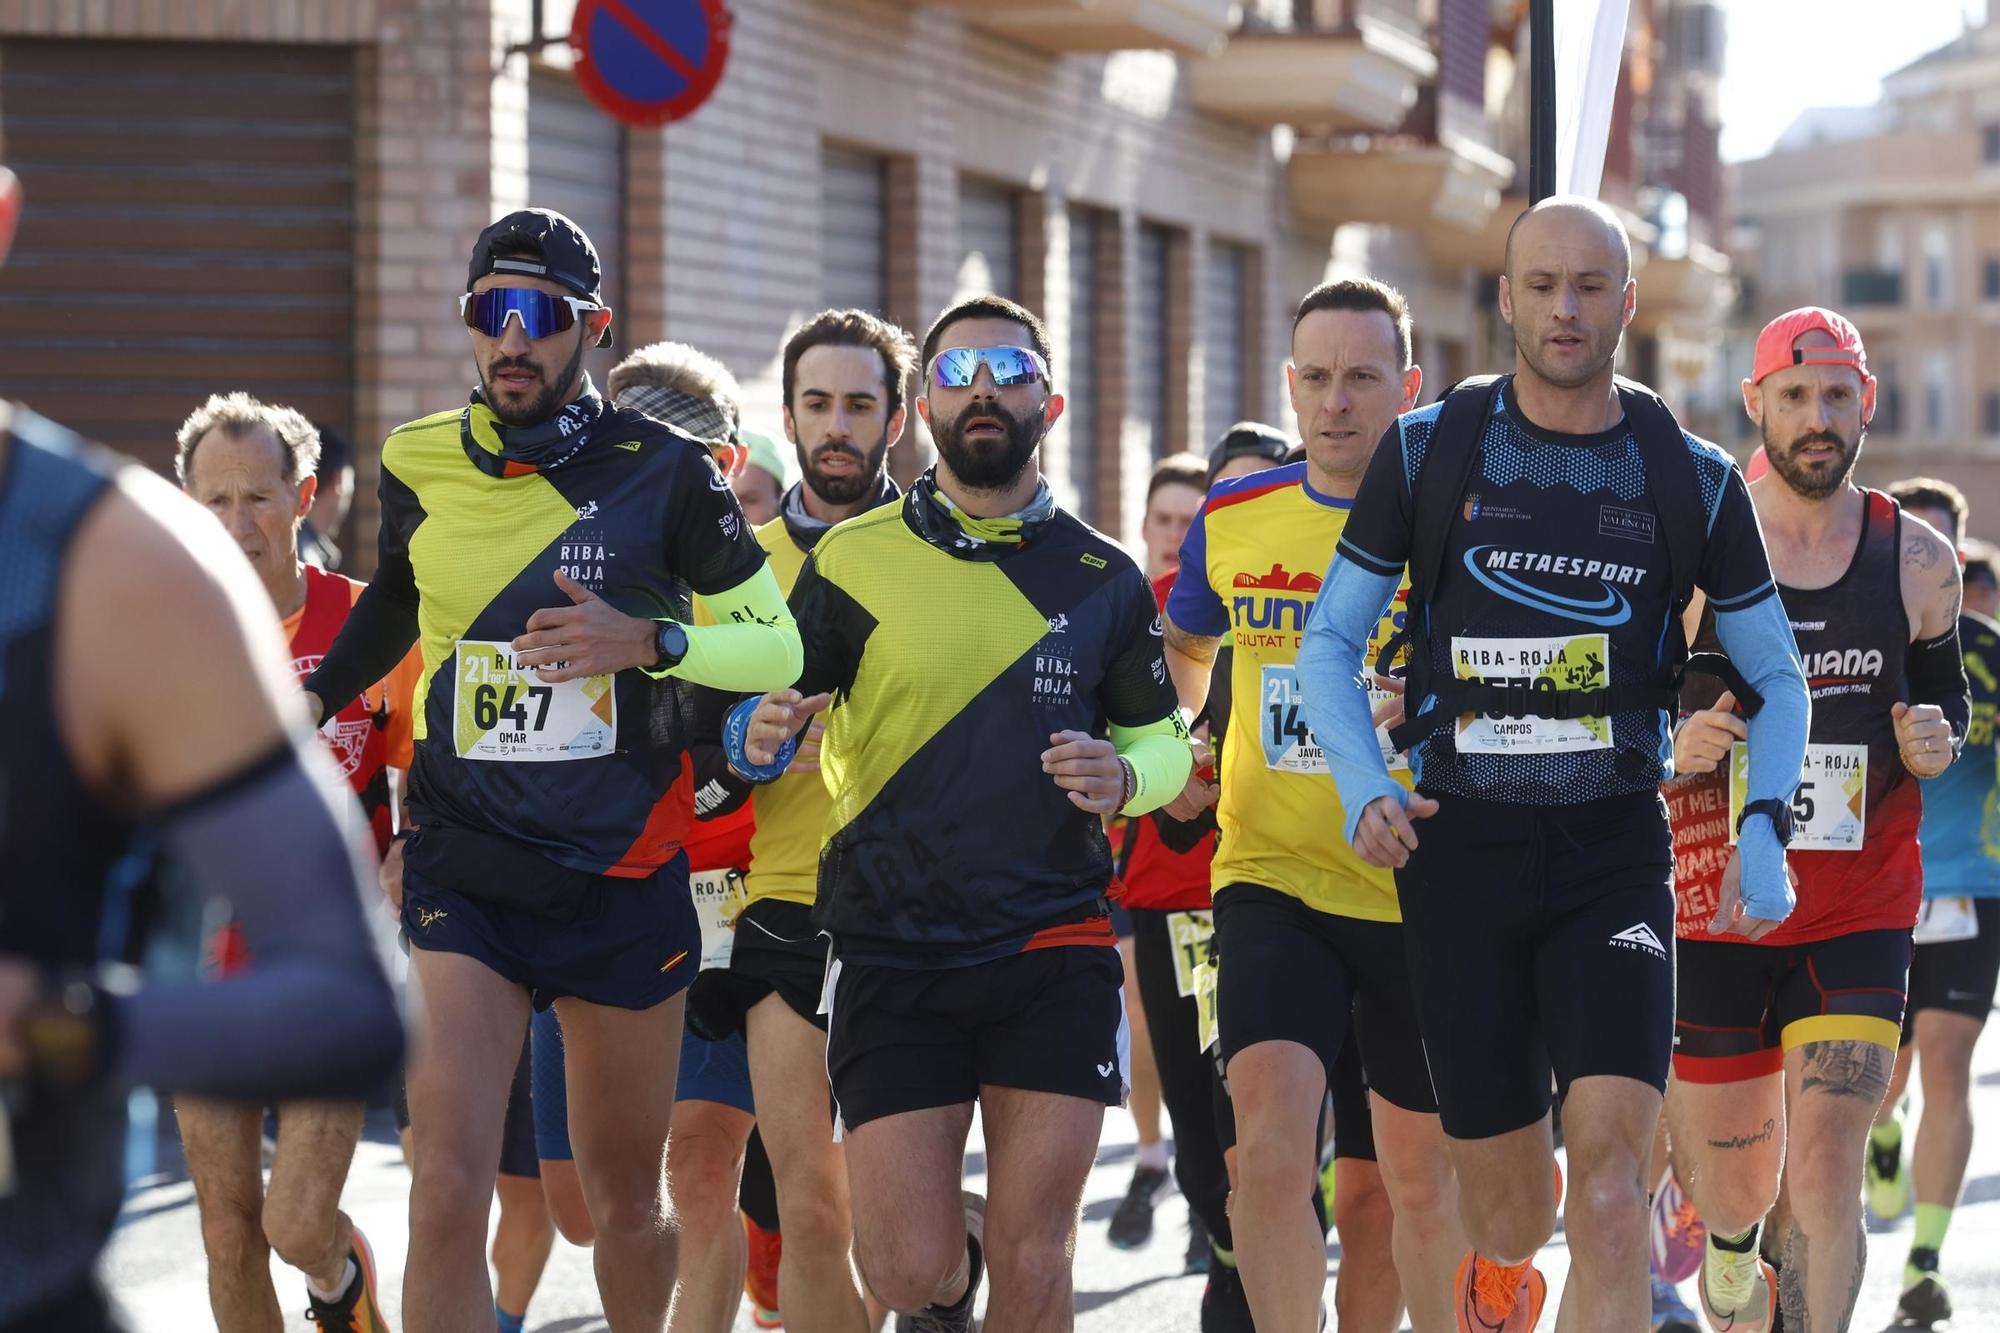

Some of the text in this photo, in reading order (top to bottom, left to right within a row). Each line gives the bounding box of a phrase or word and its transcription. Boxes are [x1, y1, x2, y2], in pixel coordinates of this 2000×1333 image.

[561, 545, 615, 560] RIBA-
[1486, 551, 1647, 585] METAESPORT
[1236, 632, 1286, 648] CIUTAT
[1803, 648, 1883, 678] LIANA
[1268, 678, 1290, 703] 21
[475, 684, 552, 731] 647
[1270, 704, 1317, 746] 14
[1494, 724, 1532, 735] CAMPOS
[500, 732, 527, 744] OMAR
[1298, 748, 1326, 758] JAVIE
[1793, 782, 1815, 822] 5
[1608, 940, 1667, 961] NIKE TRAIL
